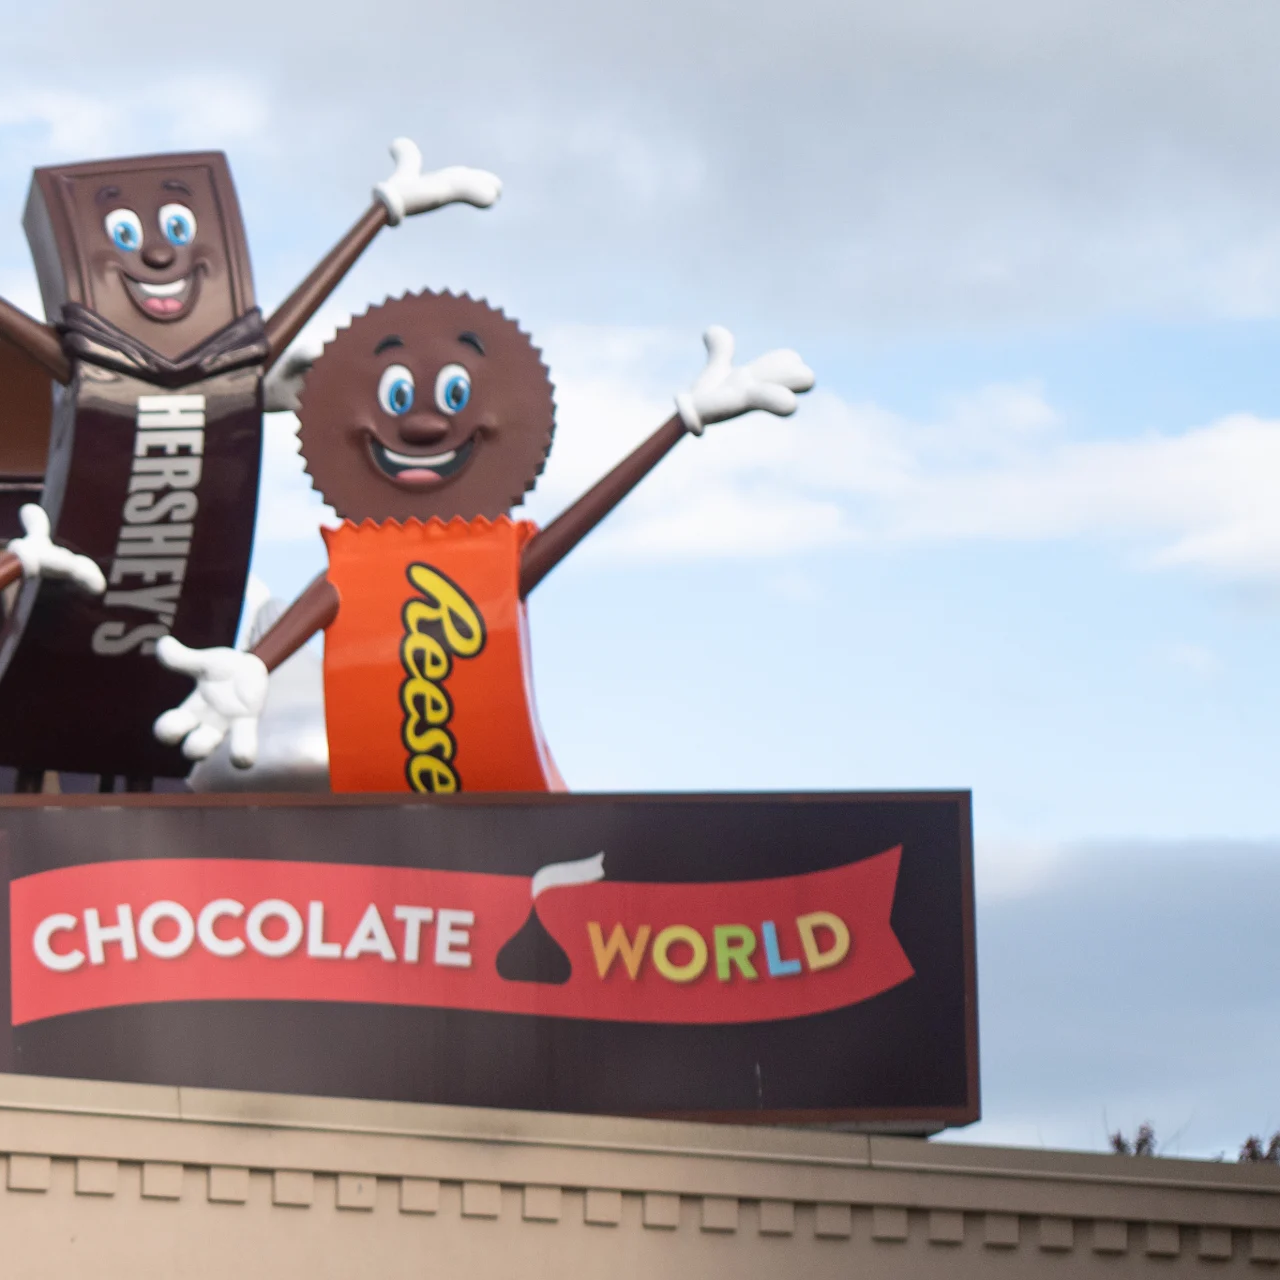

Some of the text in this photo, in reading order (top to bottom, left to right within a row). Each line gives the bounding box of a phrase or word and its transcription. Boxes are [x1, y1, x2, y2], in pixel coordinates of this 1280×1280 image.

[92, 394, 206, 656] HERSHEY'S
[400, 561, 486, 793] Reese
[32, 898, 850, 984] CHOCOLATE WORLD
